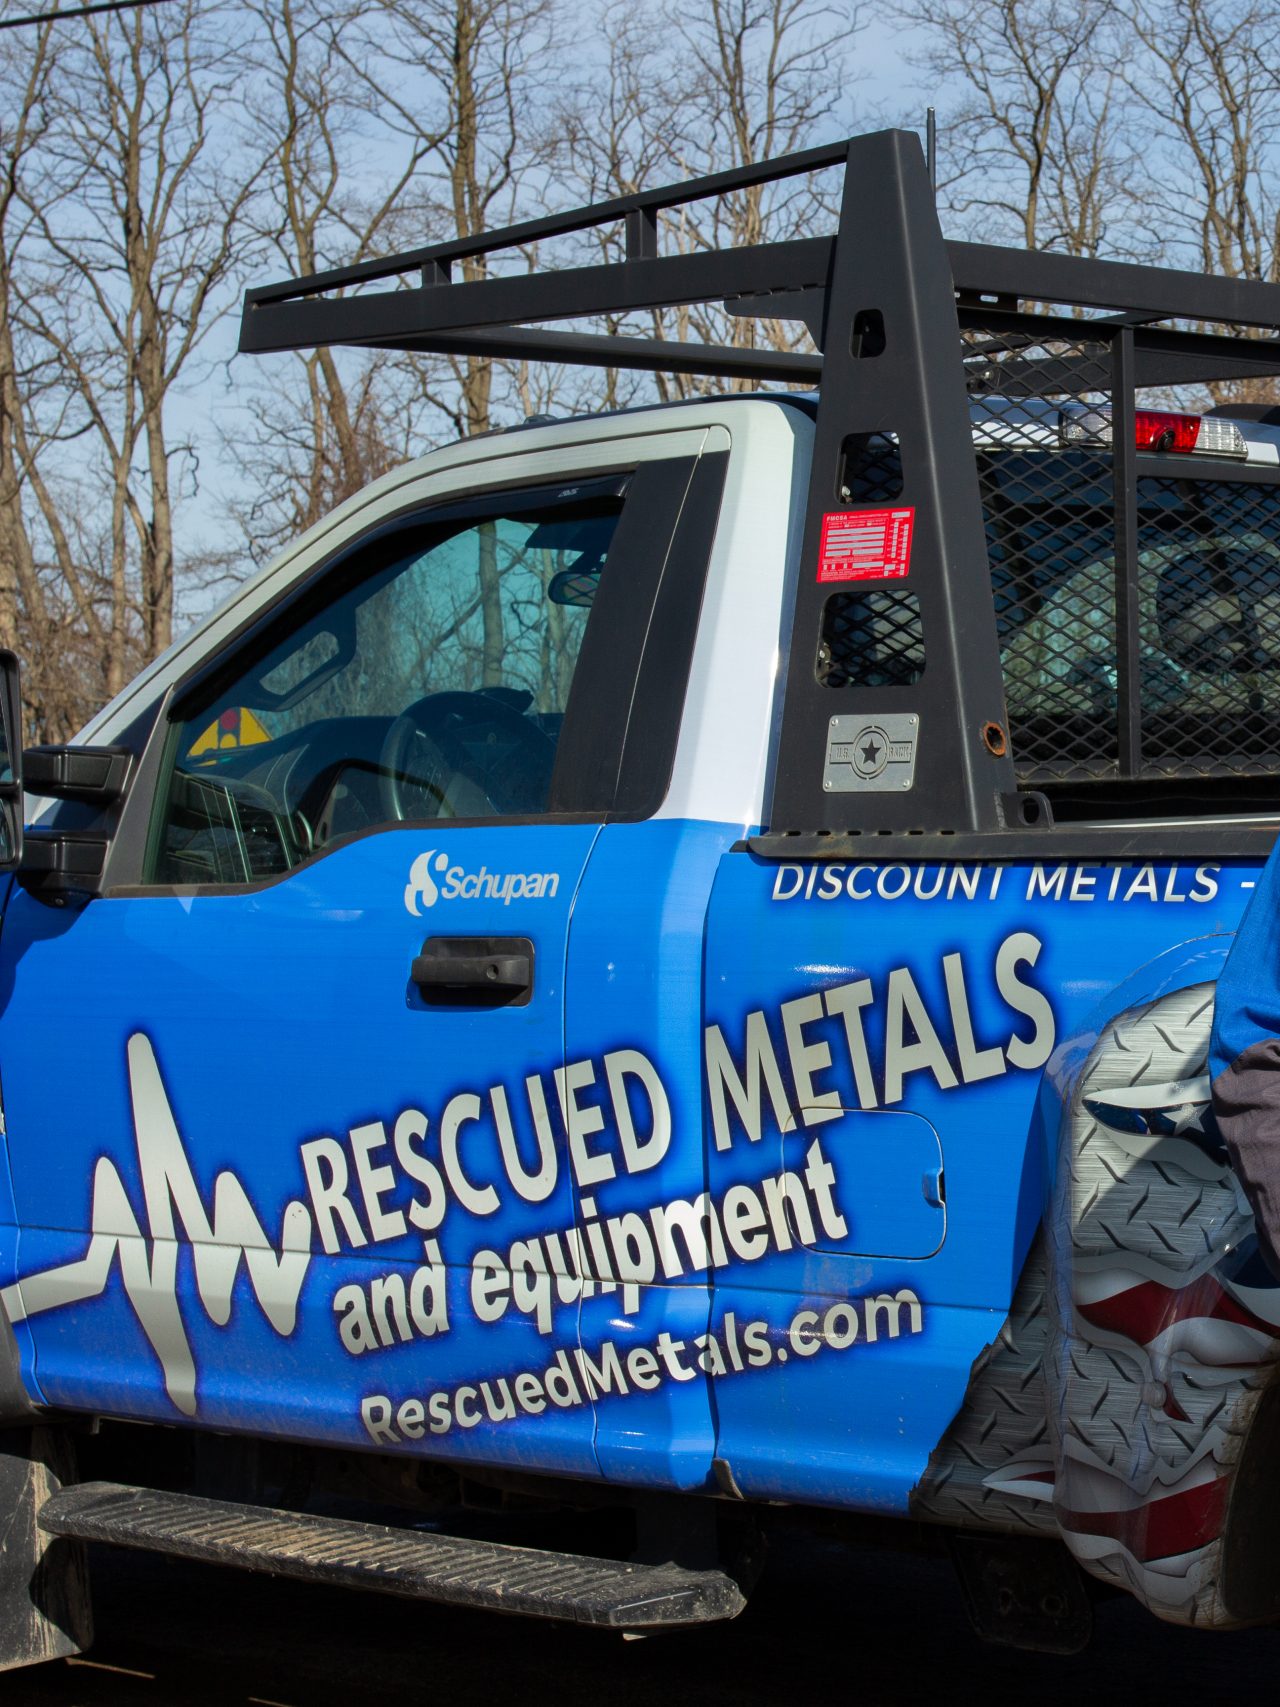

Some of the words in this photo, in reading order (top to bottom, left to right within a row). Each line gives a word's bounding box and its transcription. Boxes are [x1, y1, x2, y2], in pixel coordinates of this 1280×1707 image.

[441, 866, 560, 906] Schupan
[771, 861, 1014, 901] DISCOUNT
[1026, 861, 1220, 902] METALS
[301, 1049, 672, 1255] RESCUED
[705, 931, 1055, 1151] METALS
[333, 1239, 449, 1355] and
[470, 1137, 848, 1335] equipment
[360, 1288, 923, 1446] RescuedMetals.com
